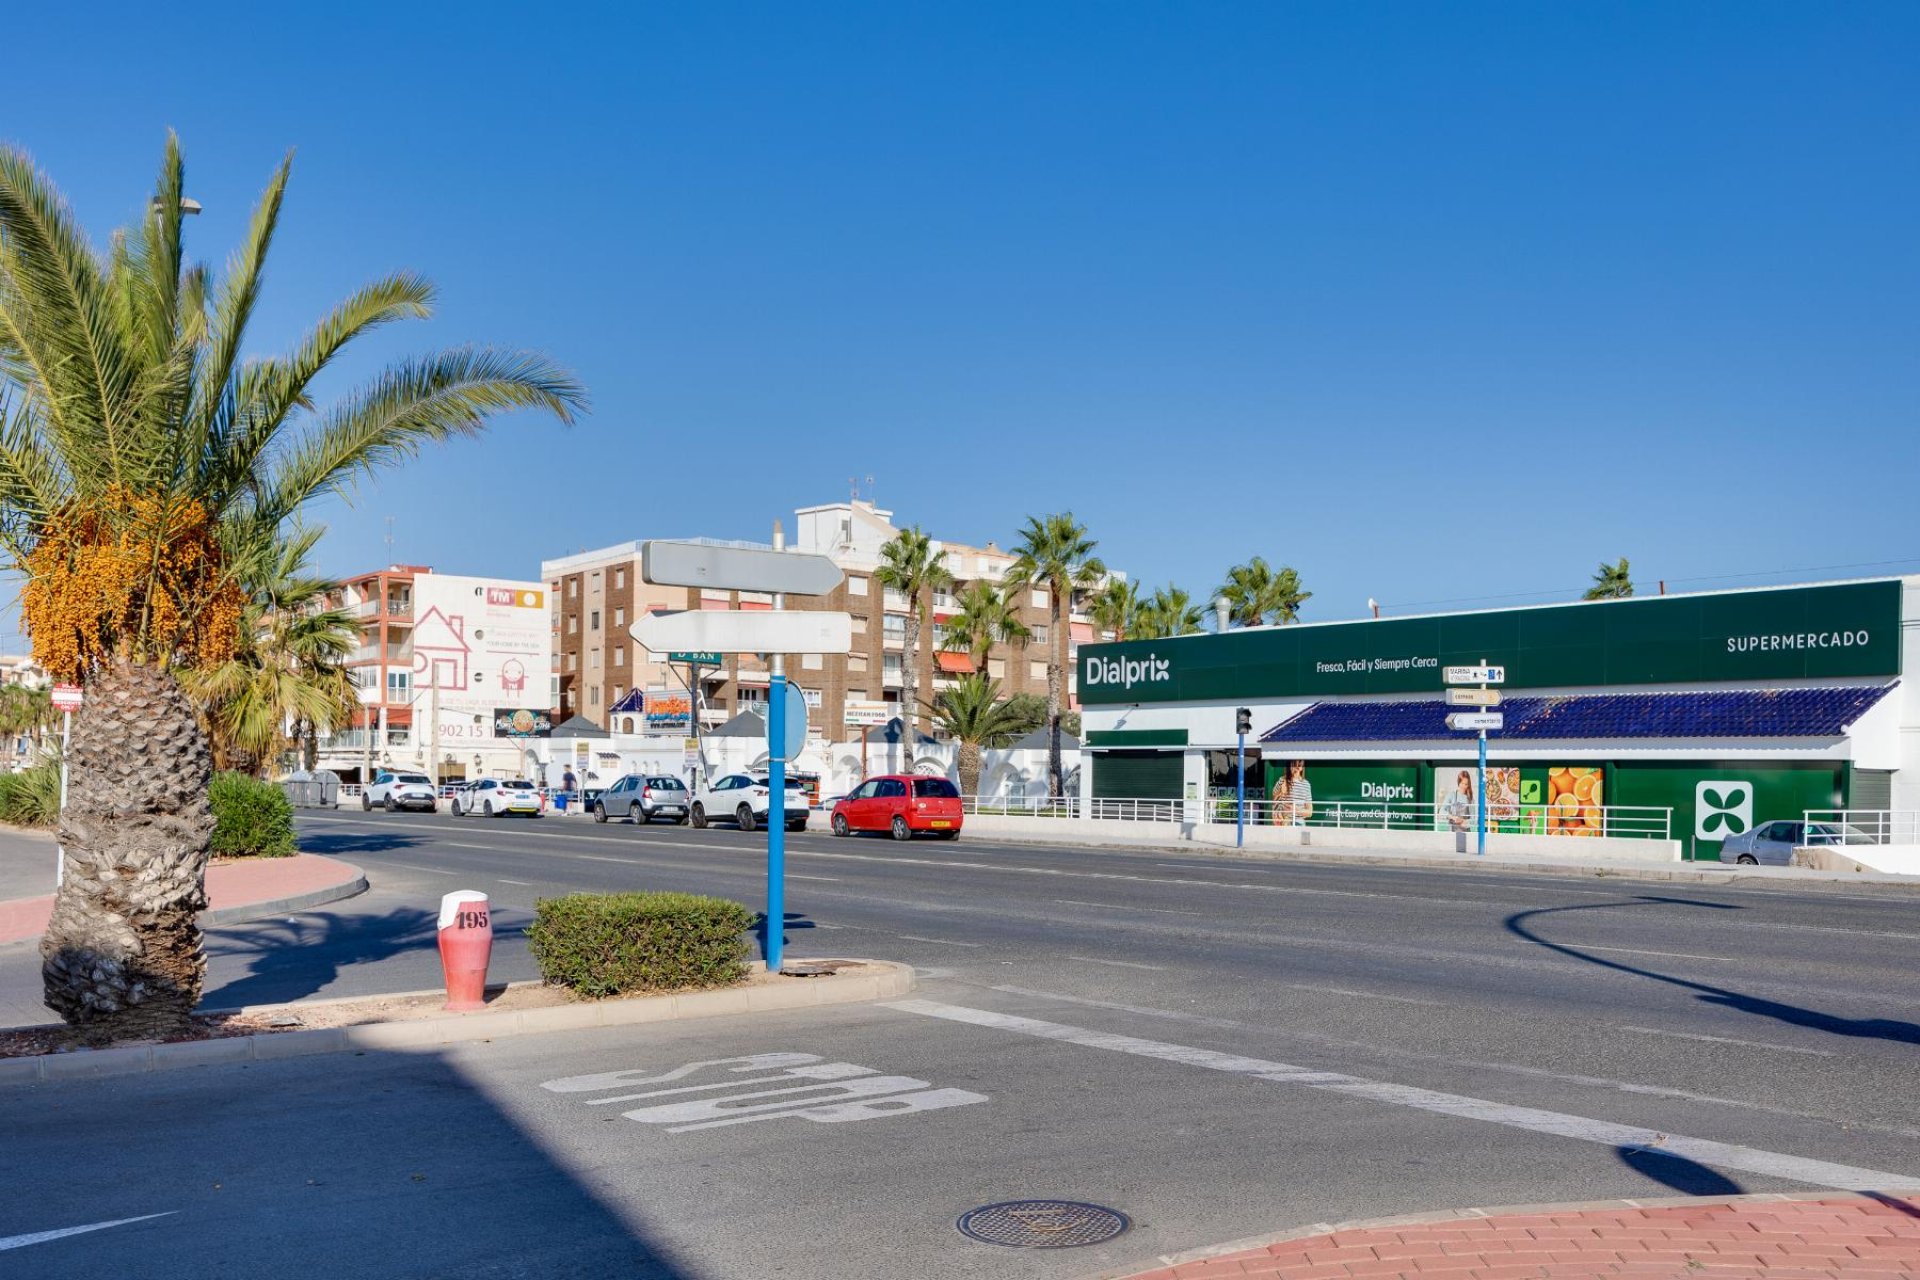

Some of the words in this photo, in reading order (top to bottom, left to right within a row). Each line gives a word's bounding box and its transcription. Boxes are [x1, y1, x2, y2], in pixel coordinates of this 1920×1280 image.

[490, 591, 510, 603] TM
[1727, 630, 1869, 653] SUPERMERCADO
[1086, 652, 1170, 690] Dialprix
[1316, 662, 1346, 673] Fresco,
[1346, 659, 1366, 671] Fácil
[1367, 661, 1373, 673] y
[1374, 658, 1410, 671] Siempre
[1411, 656, 1438, 667] Cerca
[438, 723, 464, 737] 902
[469, 724, 483, 738] 15
[1361, 782, 1414, 801] Dialprix
[1360, 808, 1373, 818] and
[1374, 809, 1391, 819] Cloe
[1400, 812, 1413, 821] you
[456, 911, 488, 930] 195
[539, 1051, 990, 1134] STOP
